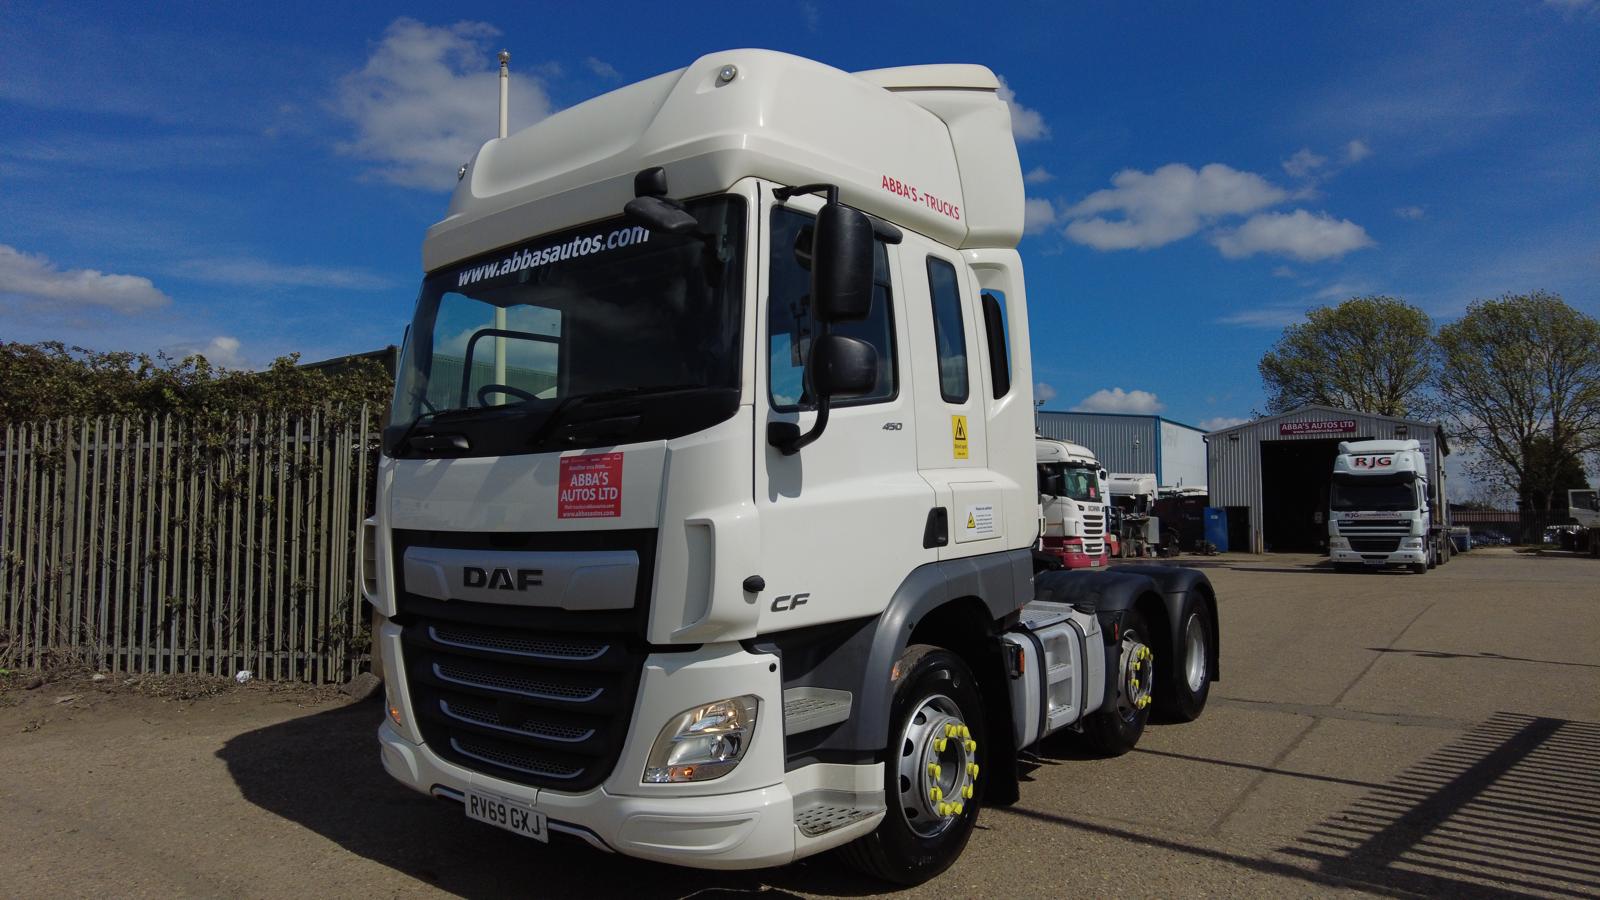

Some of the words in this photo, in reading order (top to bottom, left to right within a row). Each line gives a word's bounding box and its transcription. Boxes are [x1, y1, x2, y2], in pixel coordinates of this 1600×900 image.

[458, 225, 650, 287] www.abbasautos.com
[882, 422, 903, 431] 450
[1281, 423, 1310, 431] ABBA'S
[1311, 421, 1338, 429] AUTOS
[1355, 456, 1392, 469] RJG
[570, 471, 609, 487] ABBA'S
[560, 488, 596, 502] AUTOS
[598, 487, 618, 500] LTD
[463, 566, 544, 592] DAF
[770, 592, 811, 613] CF
[470, 794, 507, 825] RV69
[510, 807, 541, 835] GXJ
